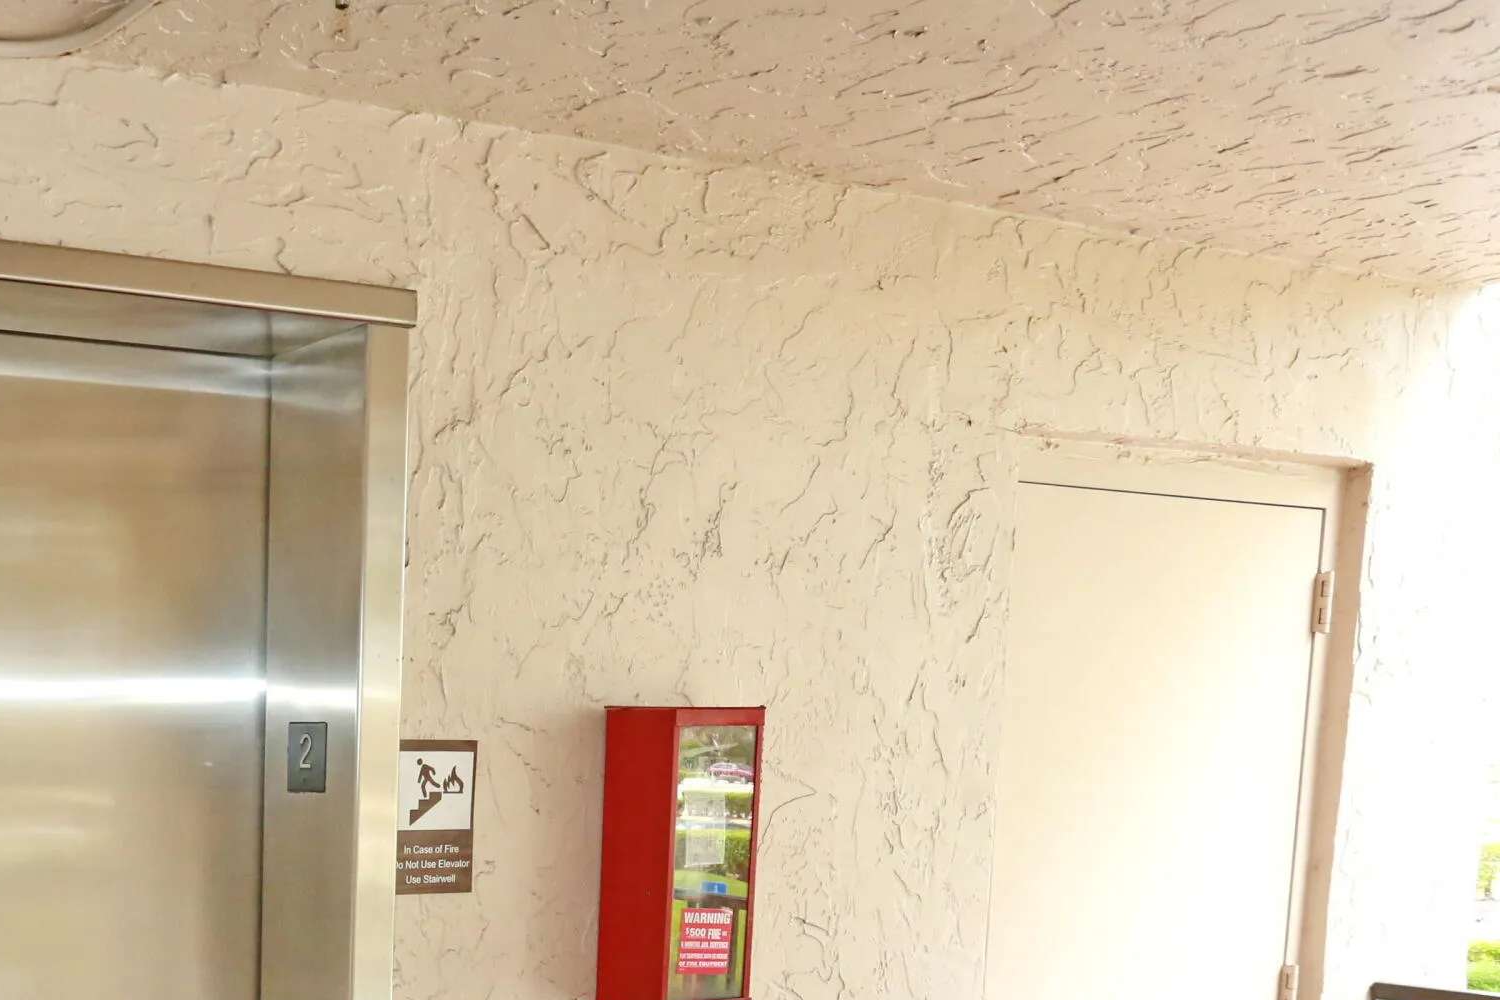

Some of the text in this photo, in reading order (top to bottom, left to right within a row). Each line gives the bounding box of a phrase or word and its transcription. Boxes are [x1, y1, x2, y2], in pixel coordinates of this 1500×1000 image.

[299, 733, 312, 769] 2
[404, 844, 460, 854] In Case of Fire
[405, 860, 419, 869] Not
[421, 860, 437, 869] Use
[438, 859, 470, 868] Elevator
[405, 874, 456, 884] Use Stairwell
[684, 912, 731, 925] WARNING
[685, 927, 706, 937] $500
[707, 928, 722, 940] FINE
